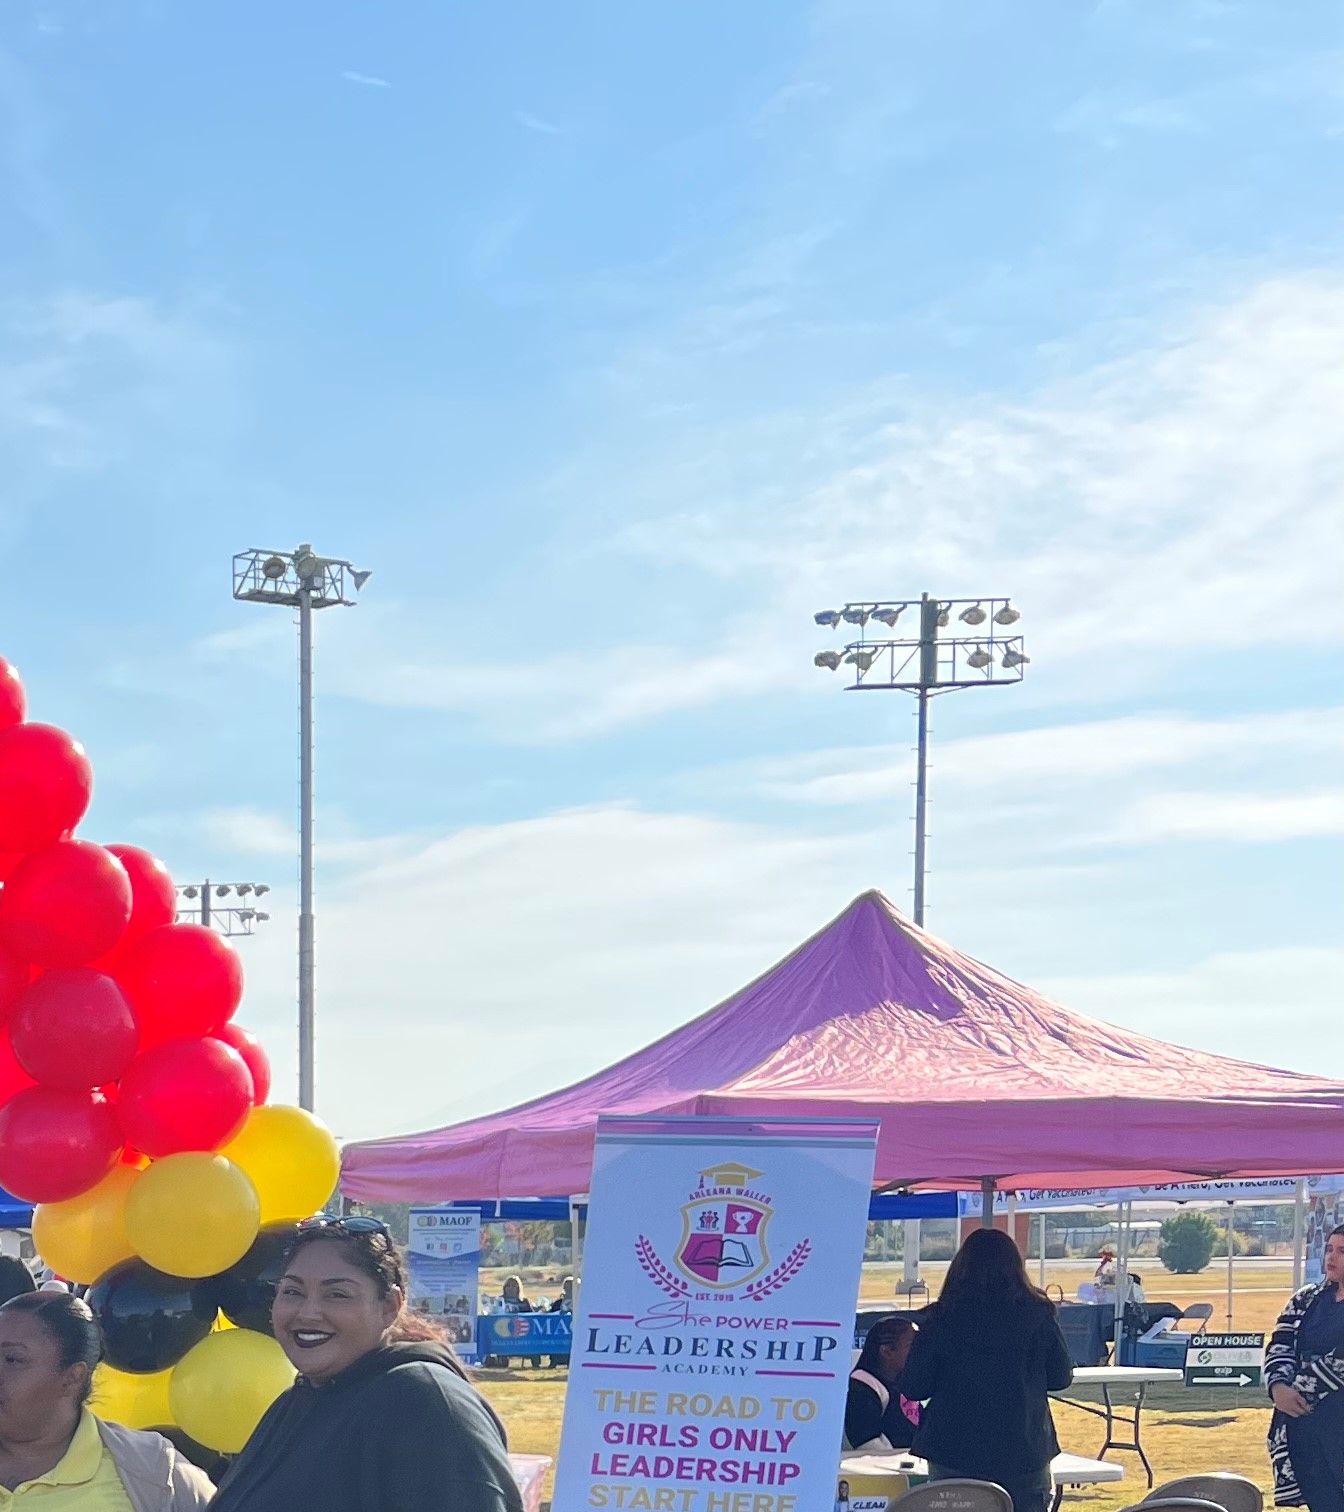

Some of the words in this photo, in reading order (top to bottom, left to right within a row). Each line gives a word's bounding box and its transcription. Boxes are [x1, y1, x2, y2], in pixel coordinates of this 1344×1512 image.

[688, 1187, 732, 1202] ARLEANA
[735, 1188, 772, 1205] WALLER
[439, 1216, 473, 1226] MAOF
[634, 1300, 712, 1330] She
[715, 1315, 789, 1331] POWER
[585, 1327, 838, 1362] LEADERSHIP
[1192, 1335, 1222, 1346] OPEN
[1224, 1335, 1261, 1346] HOUSE
[661, 1362, 750, 1377] ACADEMY
[592, 1389, 659, 1415] THE
[666, 1392, 761, 1420] ROAD
[770, 1397, 817, 1422] TO
[602, 1421, 700, 1449] GIRLS
[709, 1427, 798, 1454] ONLY
[591, 1452, 801, 1486] LEADERSHIP
[588, 1484, 699, 1512] START
[853, 1501, 886, 1510] CLEAN
